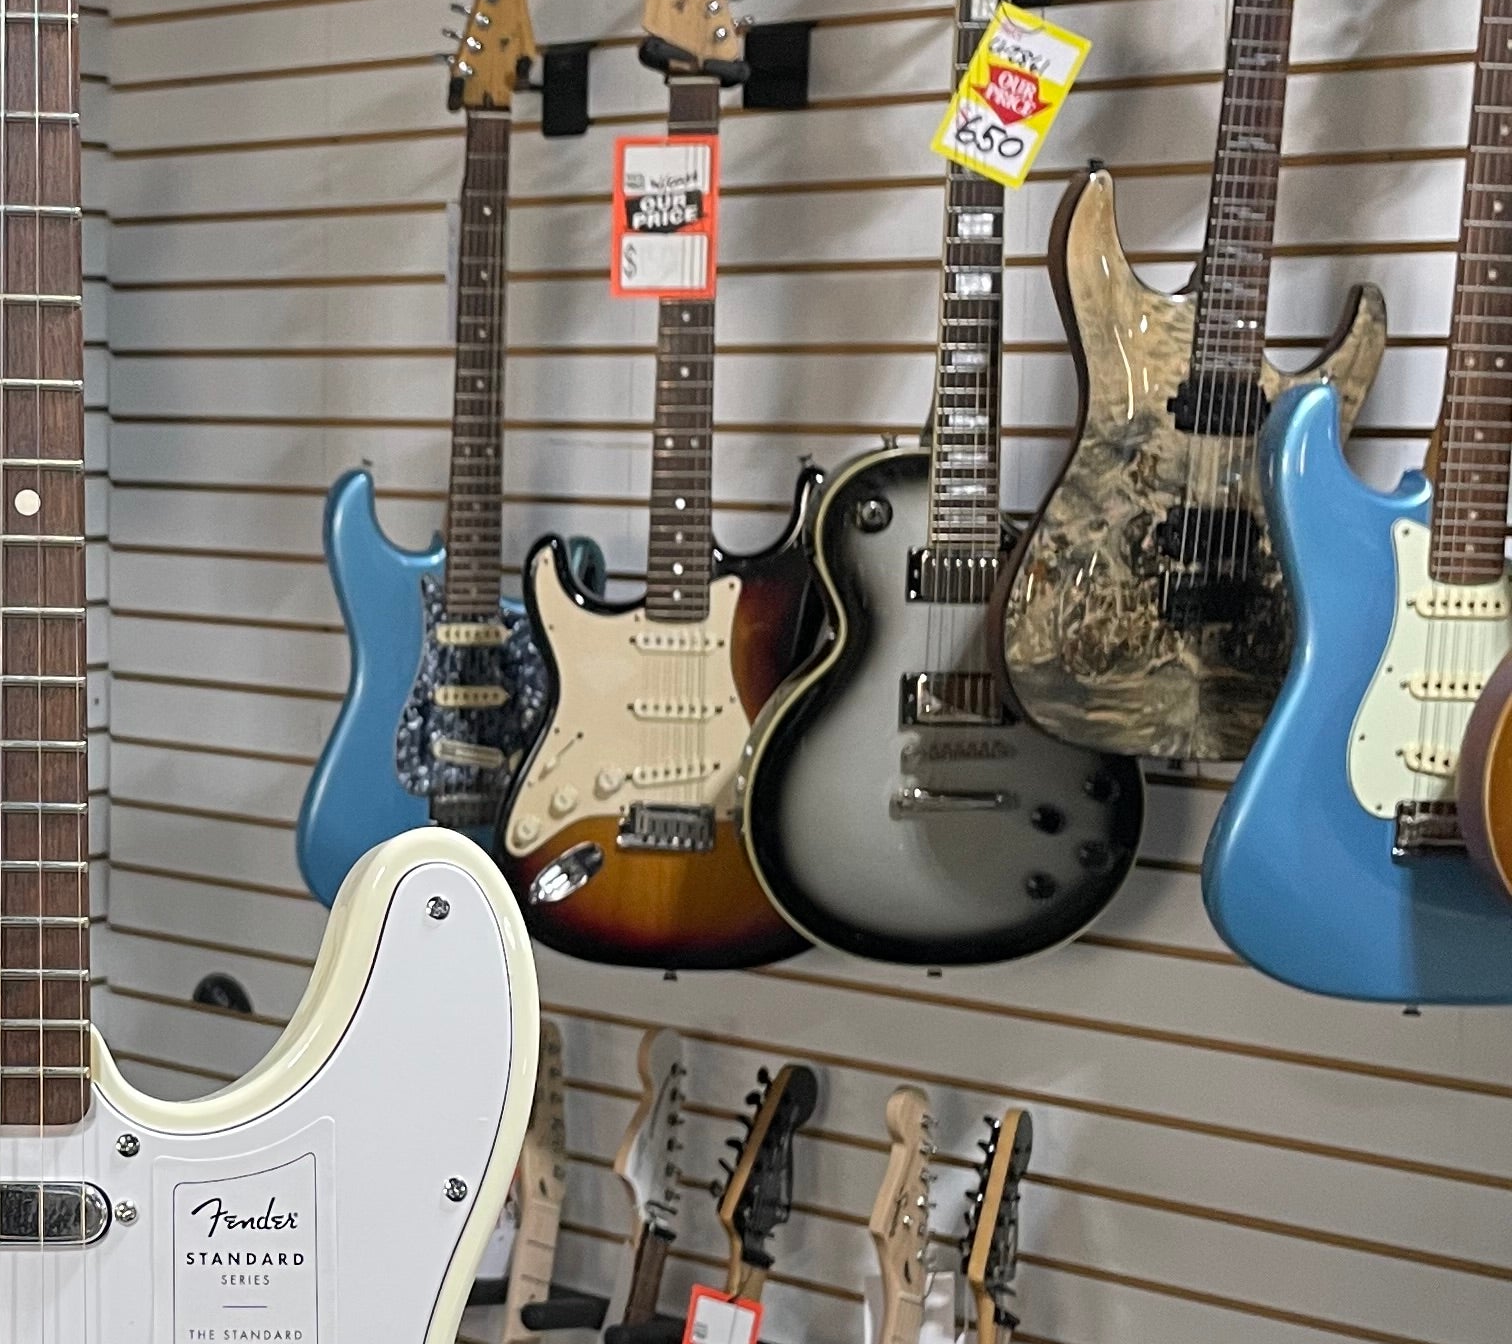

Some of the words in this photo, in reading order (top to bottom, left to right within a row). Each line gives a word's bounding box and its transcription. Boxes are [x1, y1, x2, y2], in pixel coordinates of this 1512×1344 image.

[997, 69, 1038, 101] OUR
[985, 81, 1038, 118] PRICE
[639, 194, 687, 213] OUR
[631, 203, 699, 230] PRICE
[190, 1196, 299, 1238] Fender
[186, 1252, 305, 1266] STANDARD
[220, 1274, 271, 1286] SERIES
[188, 1329, 216, 1341] THE
[223, 1329, 303, 1341] STANDARD
